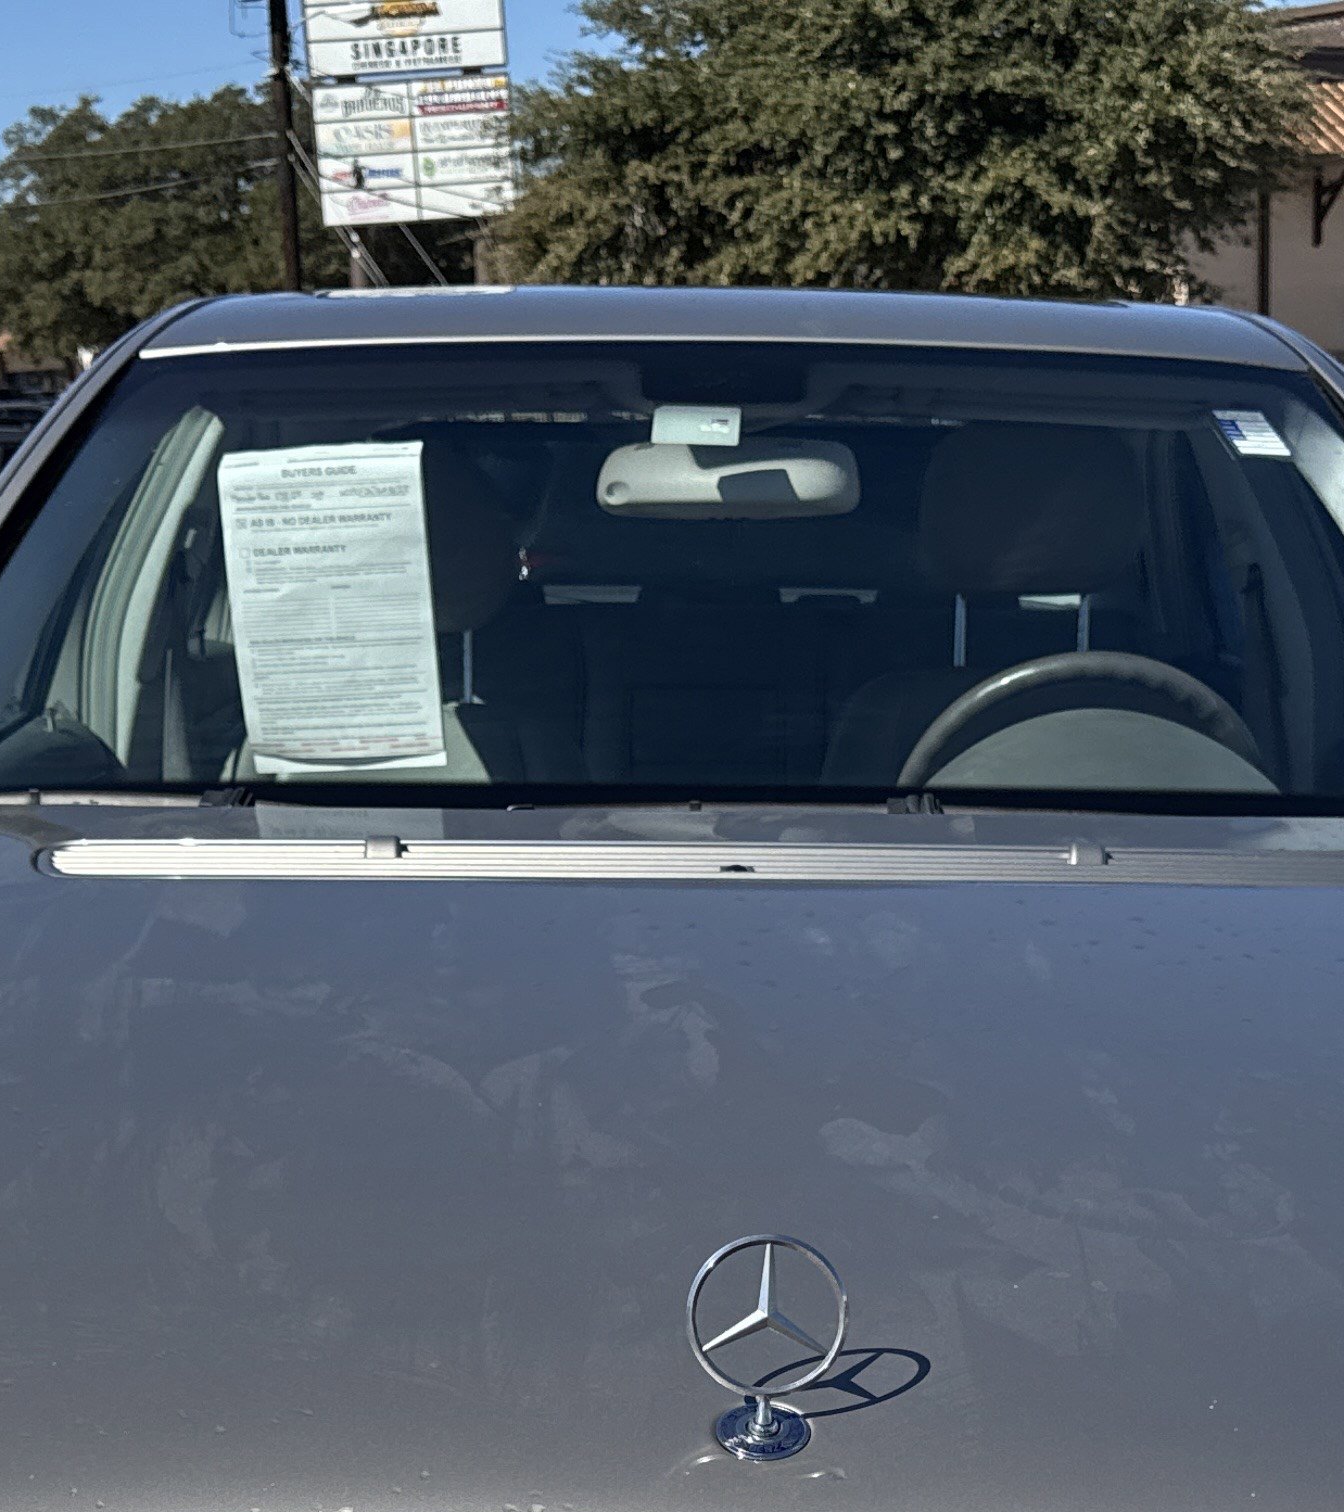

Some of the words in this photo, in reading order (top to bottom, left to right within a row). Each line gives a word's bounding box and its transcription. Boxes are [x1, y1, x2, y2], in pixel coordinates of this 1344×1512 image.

[351, 36, 462, 60] SINGAPORE
[281, 466, 323, 478] BUYERS
[324, 465, 357, 476] GUIDE
[298, 515, 336, 525] DEALER
[338, 512, 393, 523] WARRANTY
